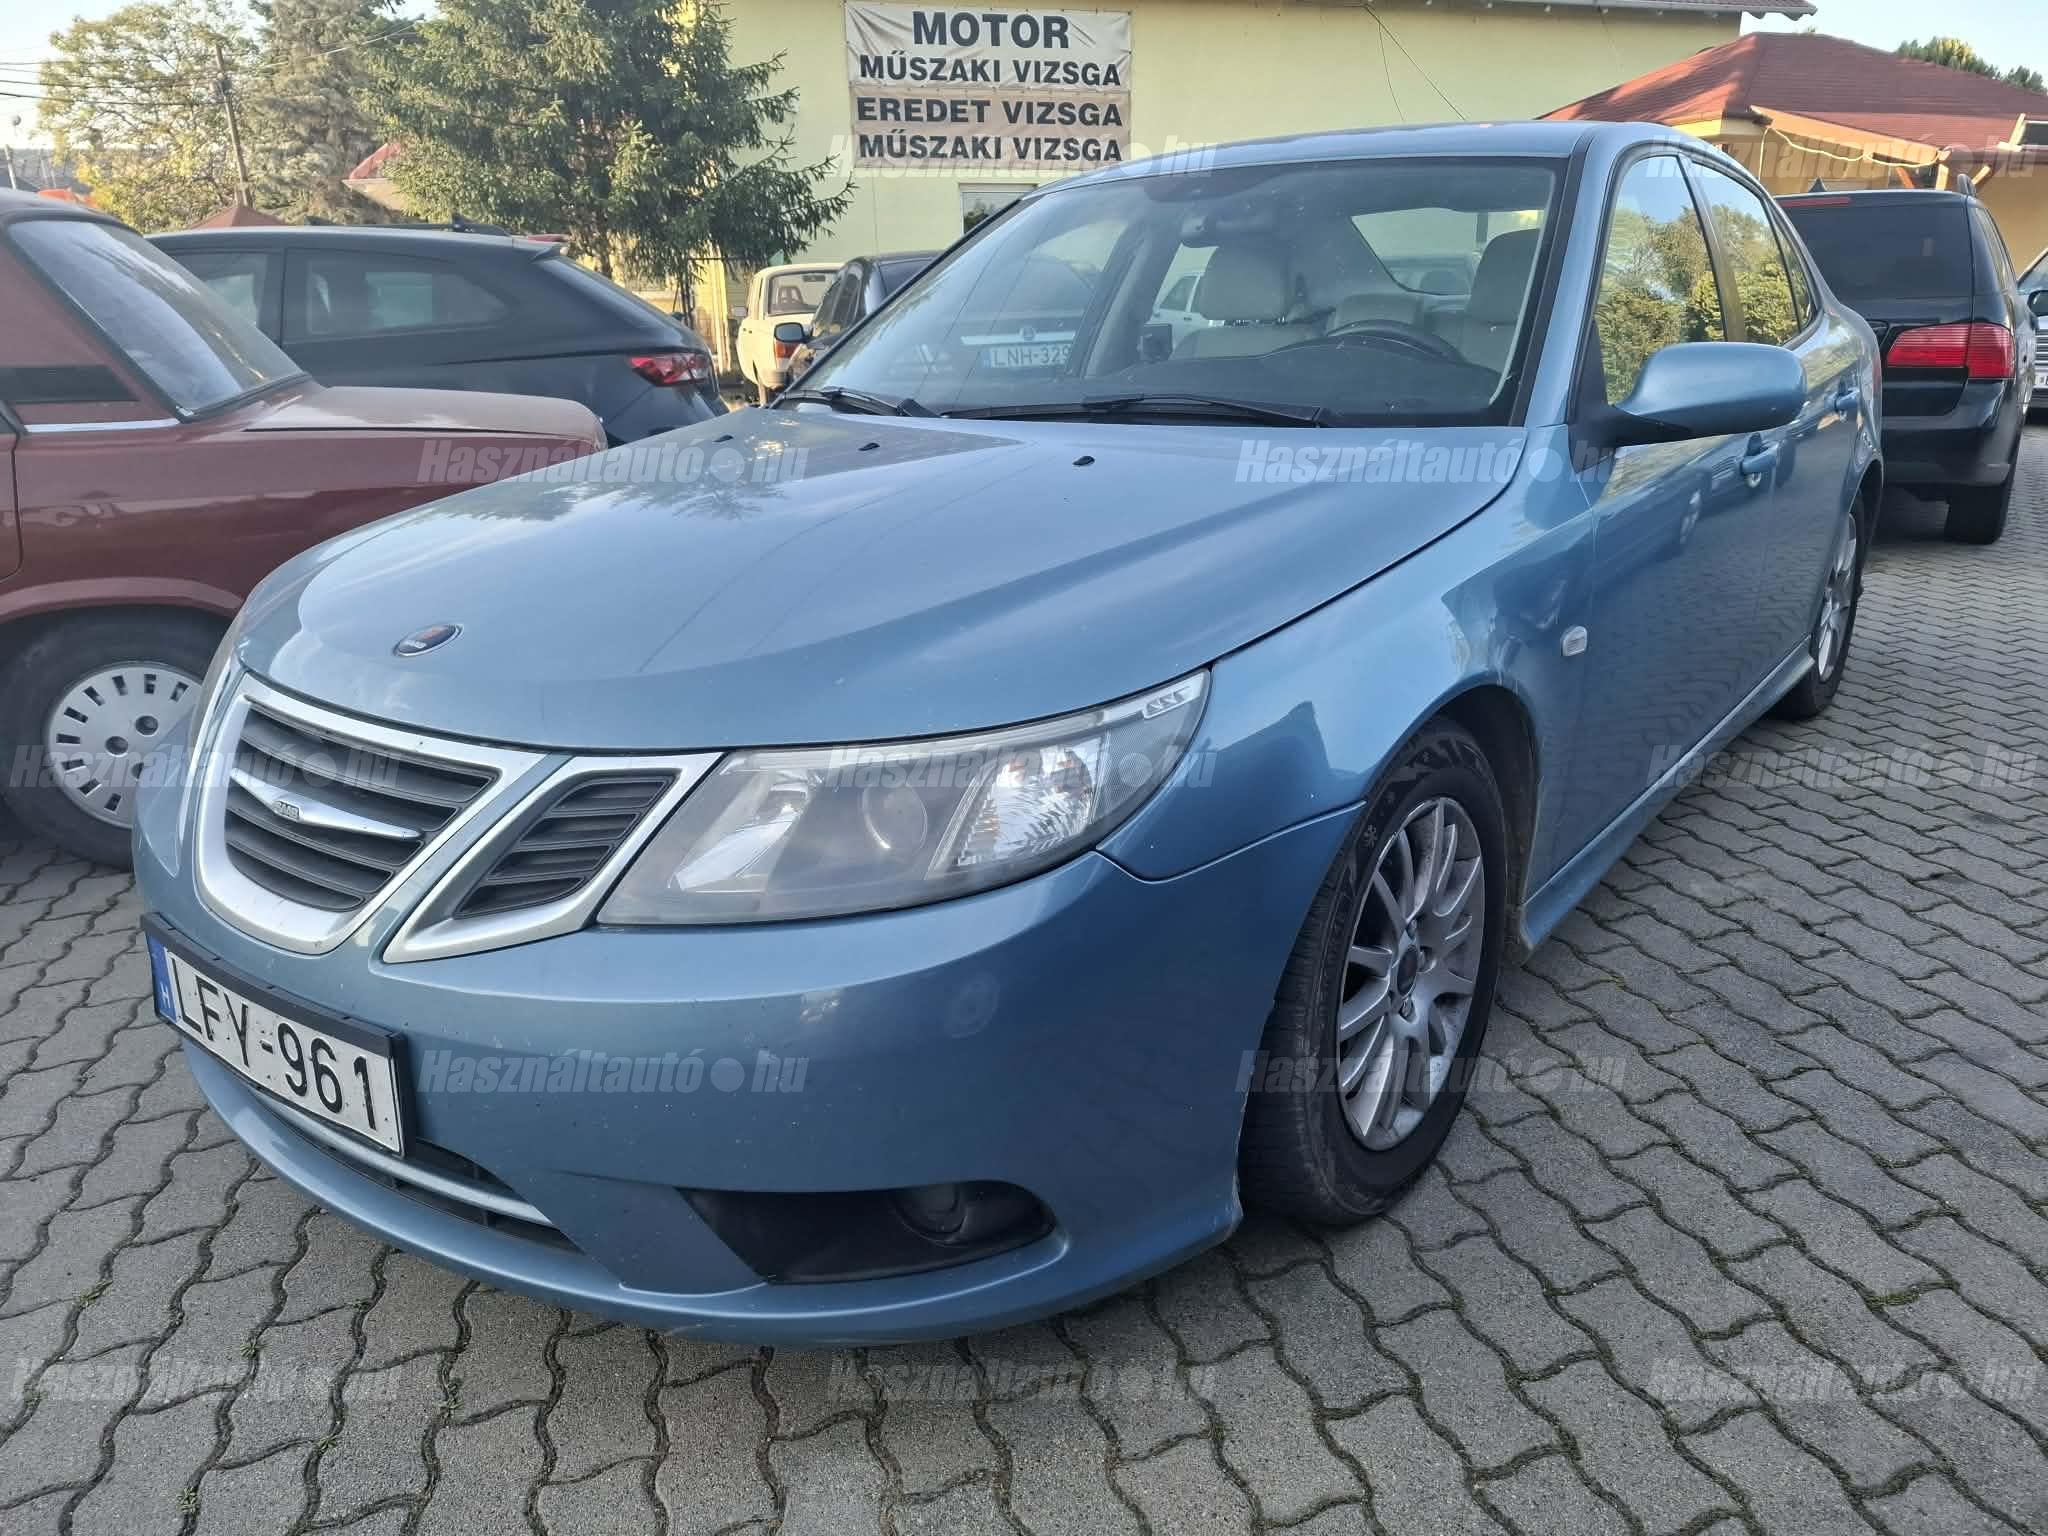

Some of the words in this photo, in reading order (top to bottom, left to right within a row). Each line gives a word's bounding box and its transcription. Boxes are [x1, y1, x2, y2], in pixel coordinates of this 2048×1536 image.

[913, 11, 1069, 48] MOTOR
[859, 50, 1000, 82] MŰSZAKI
[1012, 59, 1121, 86] VIZSGA
[857, 97, 991, 123] EREDET
[1002, 101, 1122, 126] VIZSGA
[859, 130, 1001, 160] MŰSZAKI
[1012, 136, 1122, 161] VIZSGA
[172, 958, 377, 1131] LFY-961
